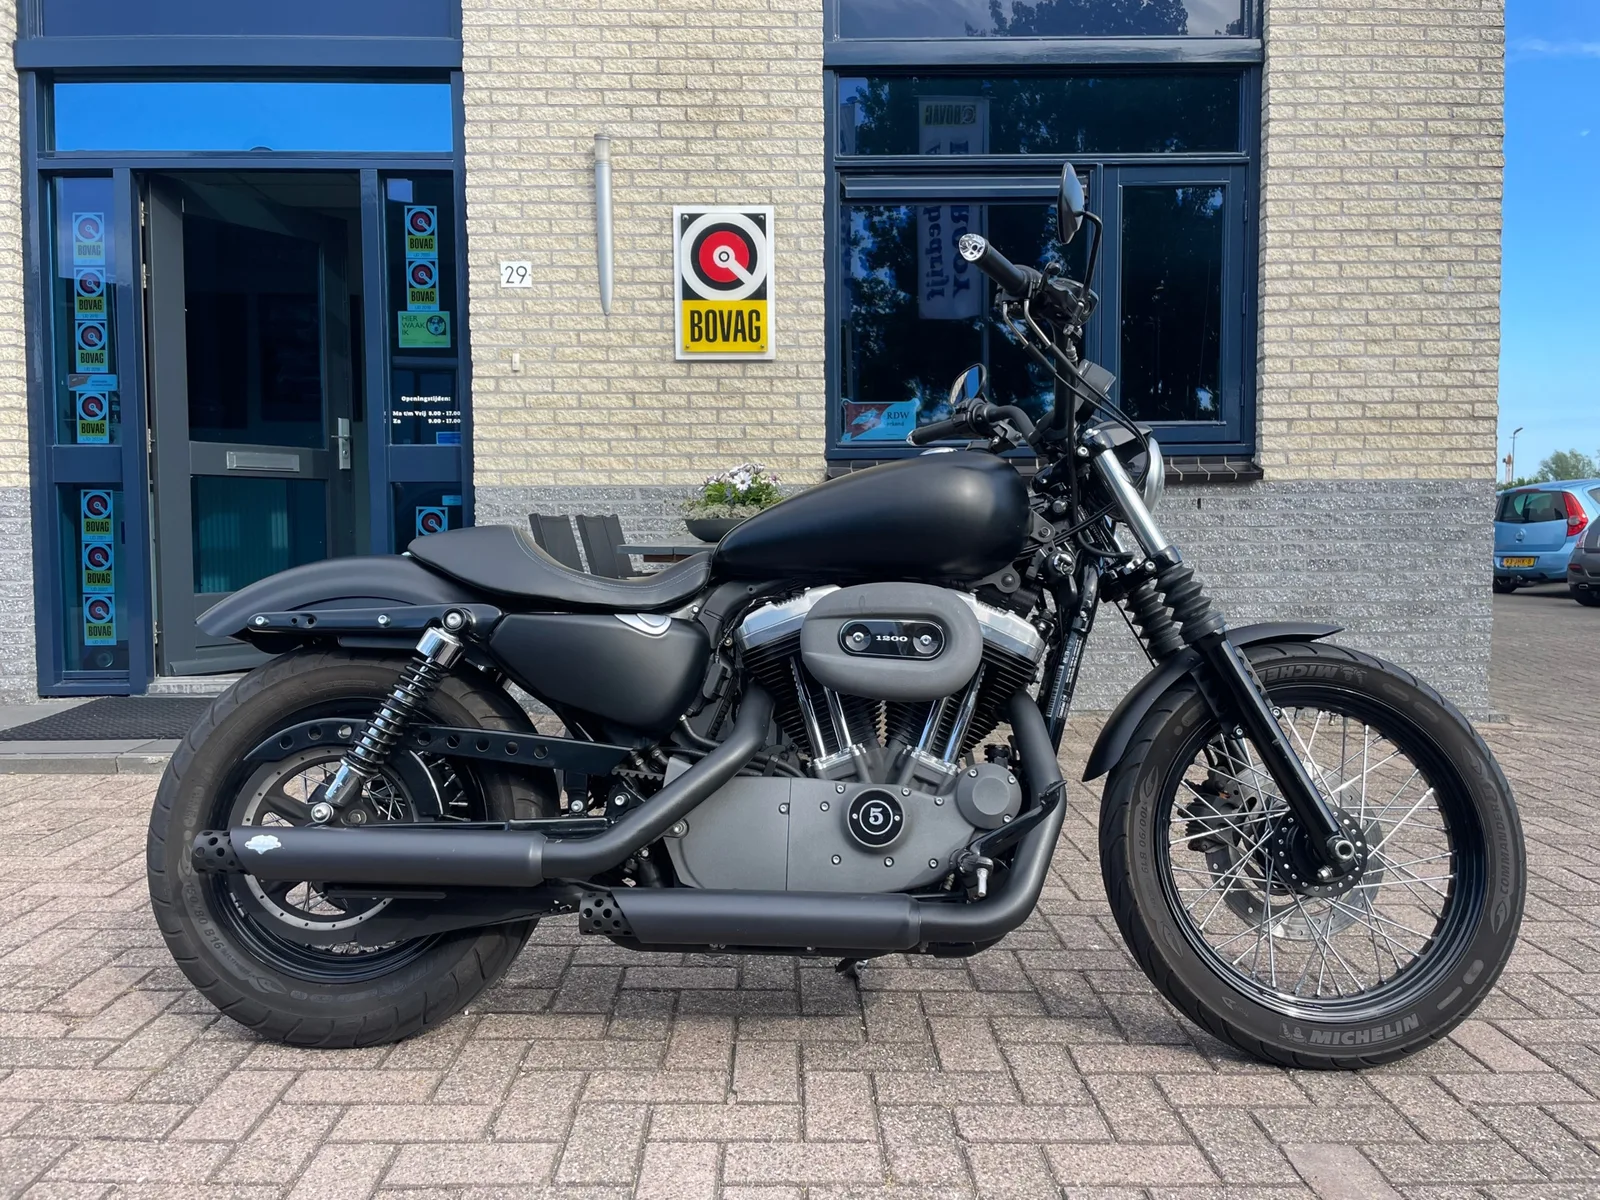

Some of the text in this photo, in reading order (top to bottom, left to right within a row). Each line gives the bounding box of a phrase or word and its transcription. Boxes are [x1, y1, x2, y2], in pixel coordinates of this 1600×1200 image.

[77, 244, 102, 256] BOVAG
[409, 238, 434, 250] BOVAG
[505, 265, 528, 285] 29
[411, 290, 435, 302] BOVAG
[78, 299, 103, 311] BOVAG
[689, 309, 761, 343] BOVAG
[80, 352, 104, 364] BOVAG
[401, 395, 451, 403] Openingstijden:
[886, 411, 909, 420] RDW
[81, 422, 105, 434] BOVAG
[85, 521, 110, 532] BOVAG
[87, 572, 111, 584] BOVAG
[88, 625, 112, 637] BOVAG
[875, 634, 909, 643] 1200
[1257, 665, 1339, 682] MICHEL
[868, 807, 884, 826] 5
[1491, 803, 1510, 895] COMMANDER
[203, 928, 225, 950] B16
[1309, 1013, 1420, 1045] MICHELIN
